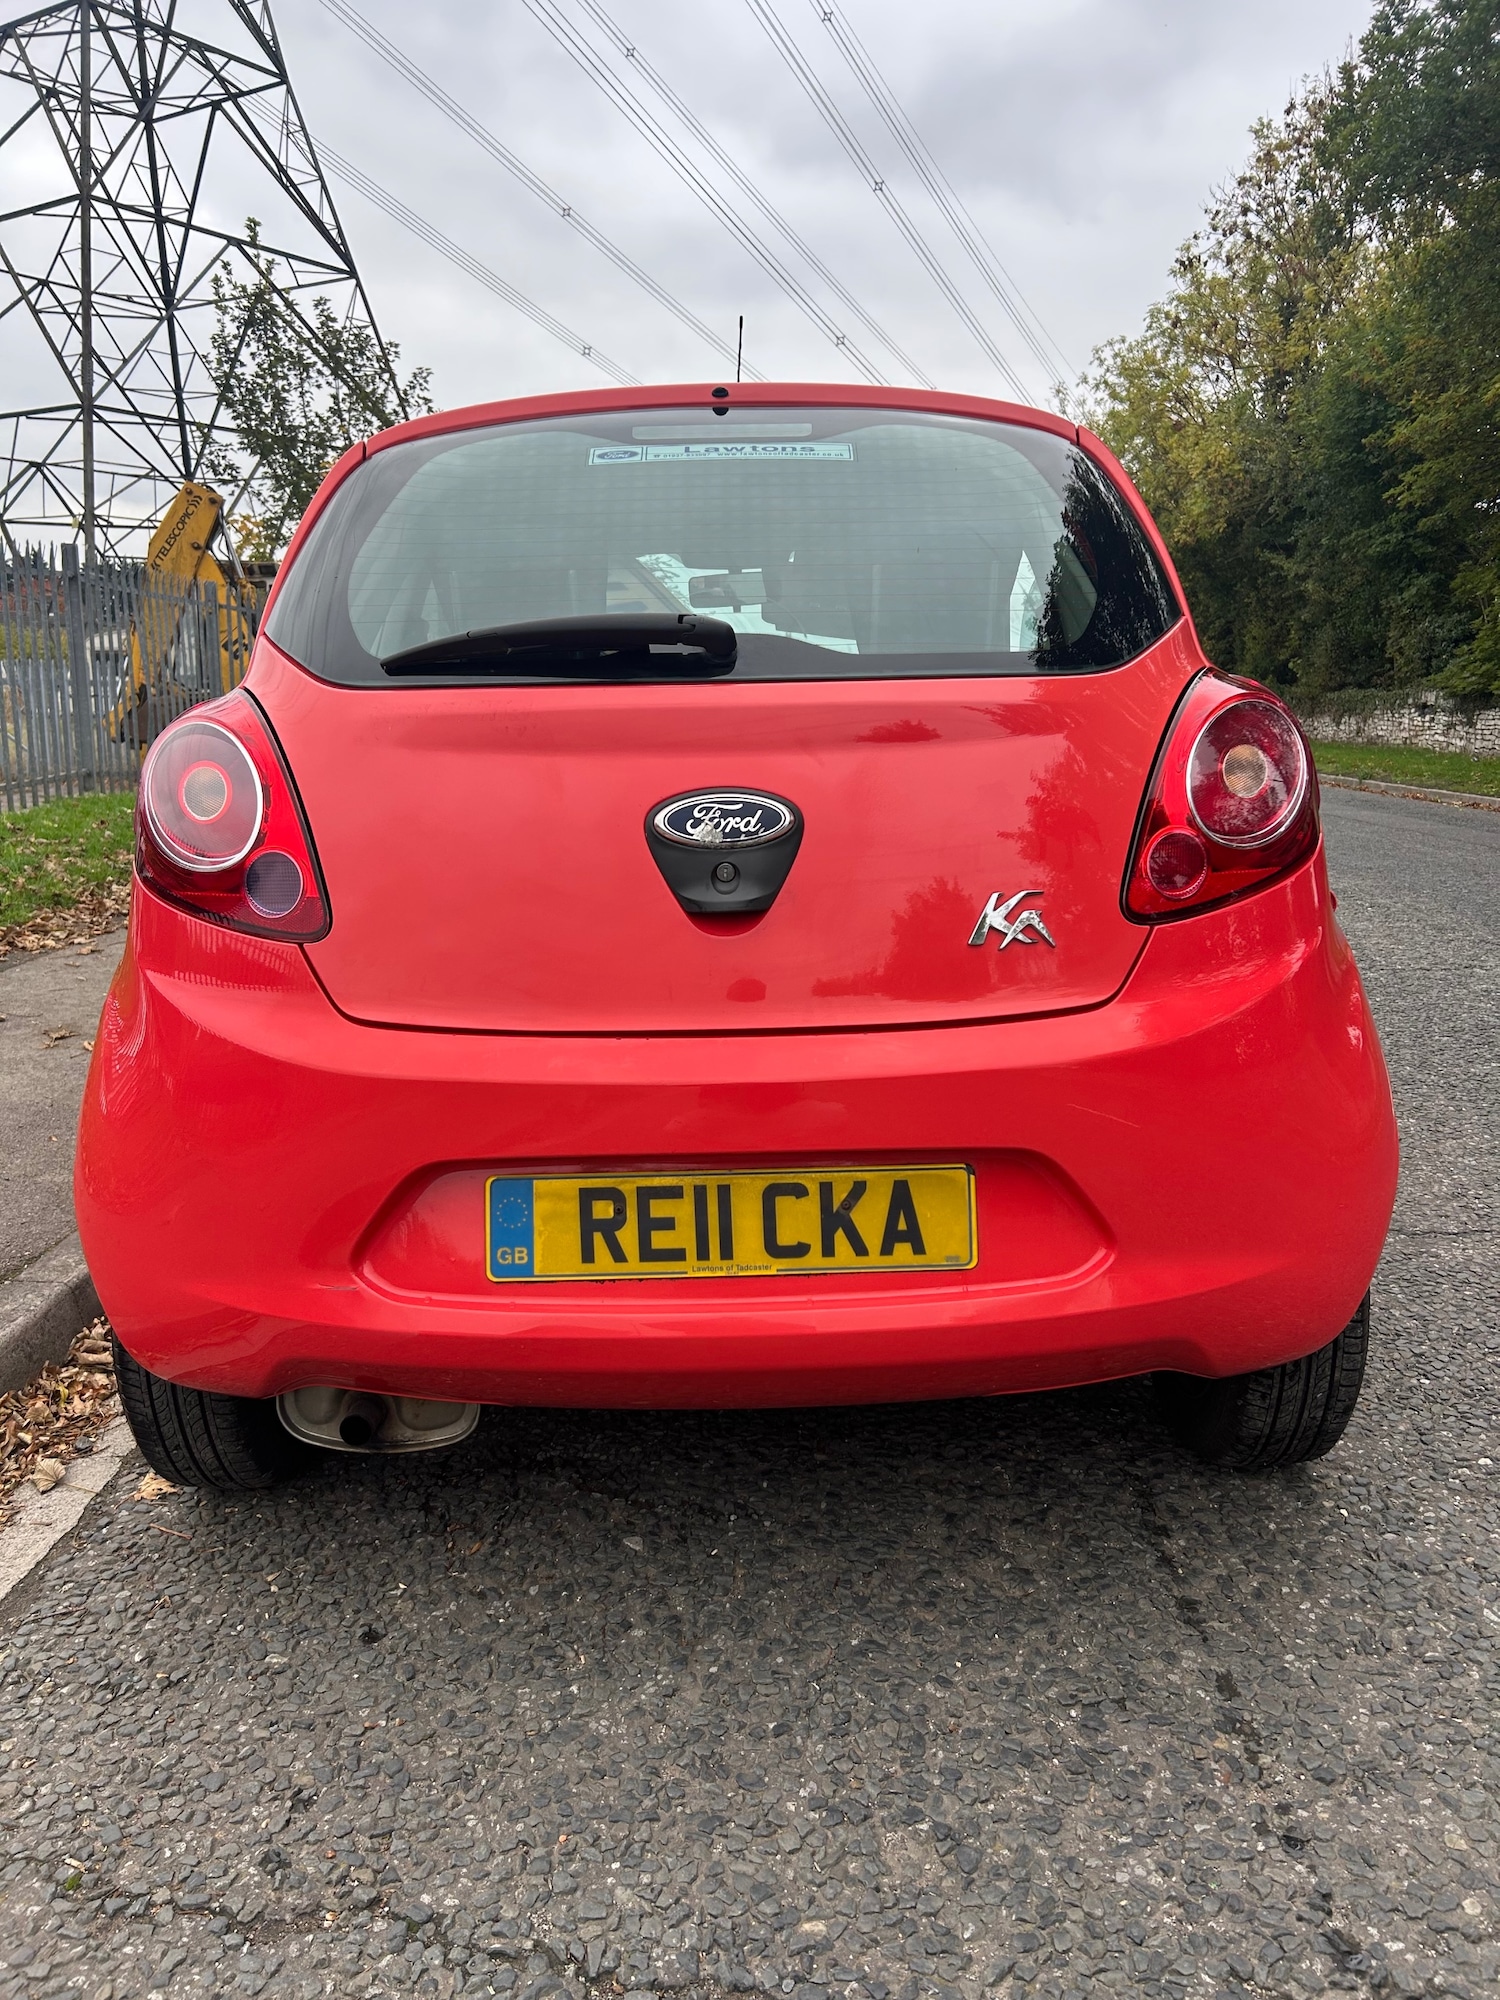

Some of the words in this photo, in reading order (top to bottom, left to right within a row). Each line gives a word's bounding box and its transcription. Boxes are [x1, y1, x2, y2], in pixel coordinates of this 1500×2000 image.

[684, 445, 815, 453] Lawtons
[154, 505, 195, 562] TELESCOPIC
[686, 803, 763, 834] Ford
[763, 1179, 927, 1259] CKA
[497, 1247, 528, 1265] GB
[692, 1265, 724, 1273] Lawtons
[736, 1264, 772, 1272] Tadcaster
